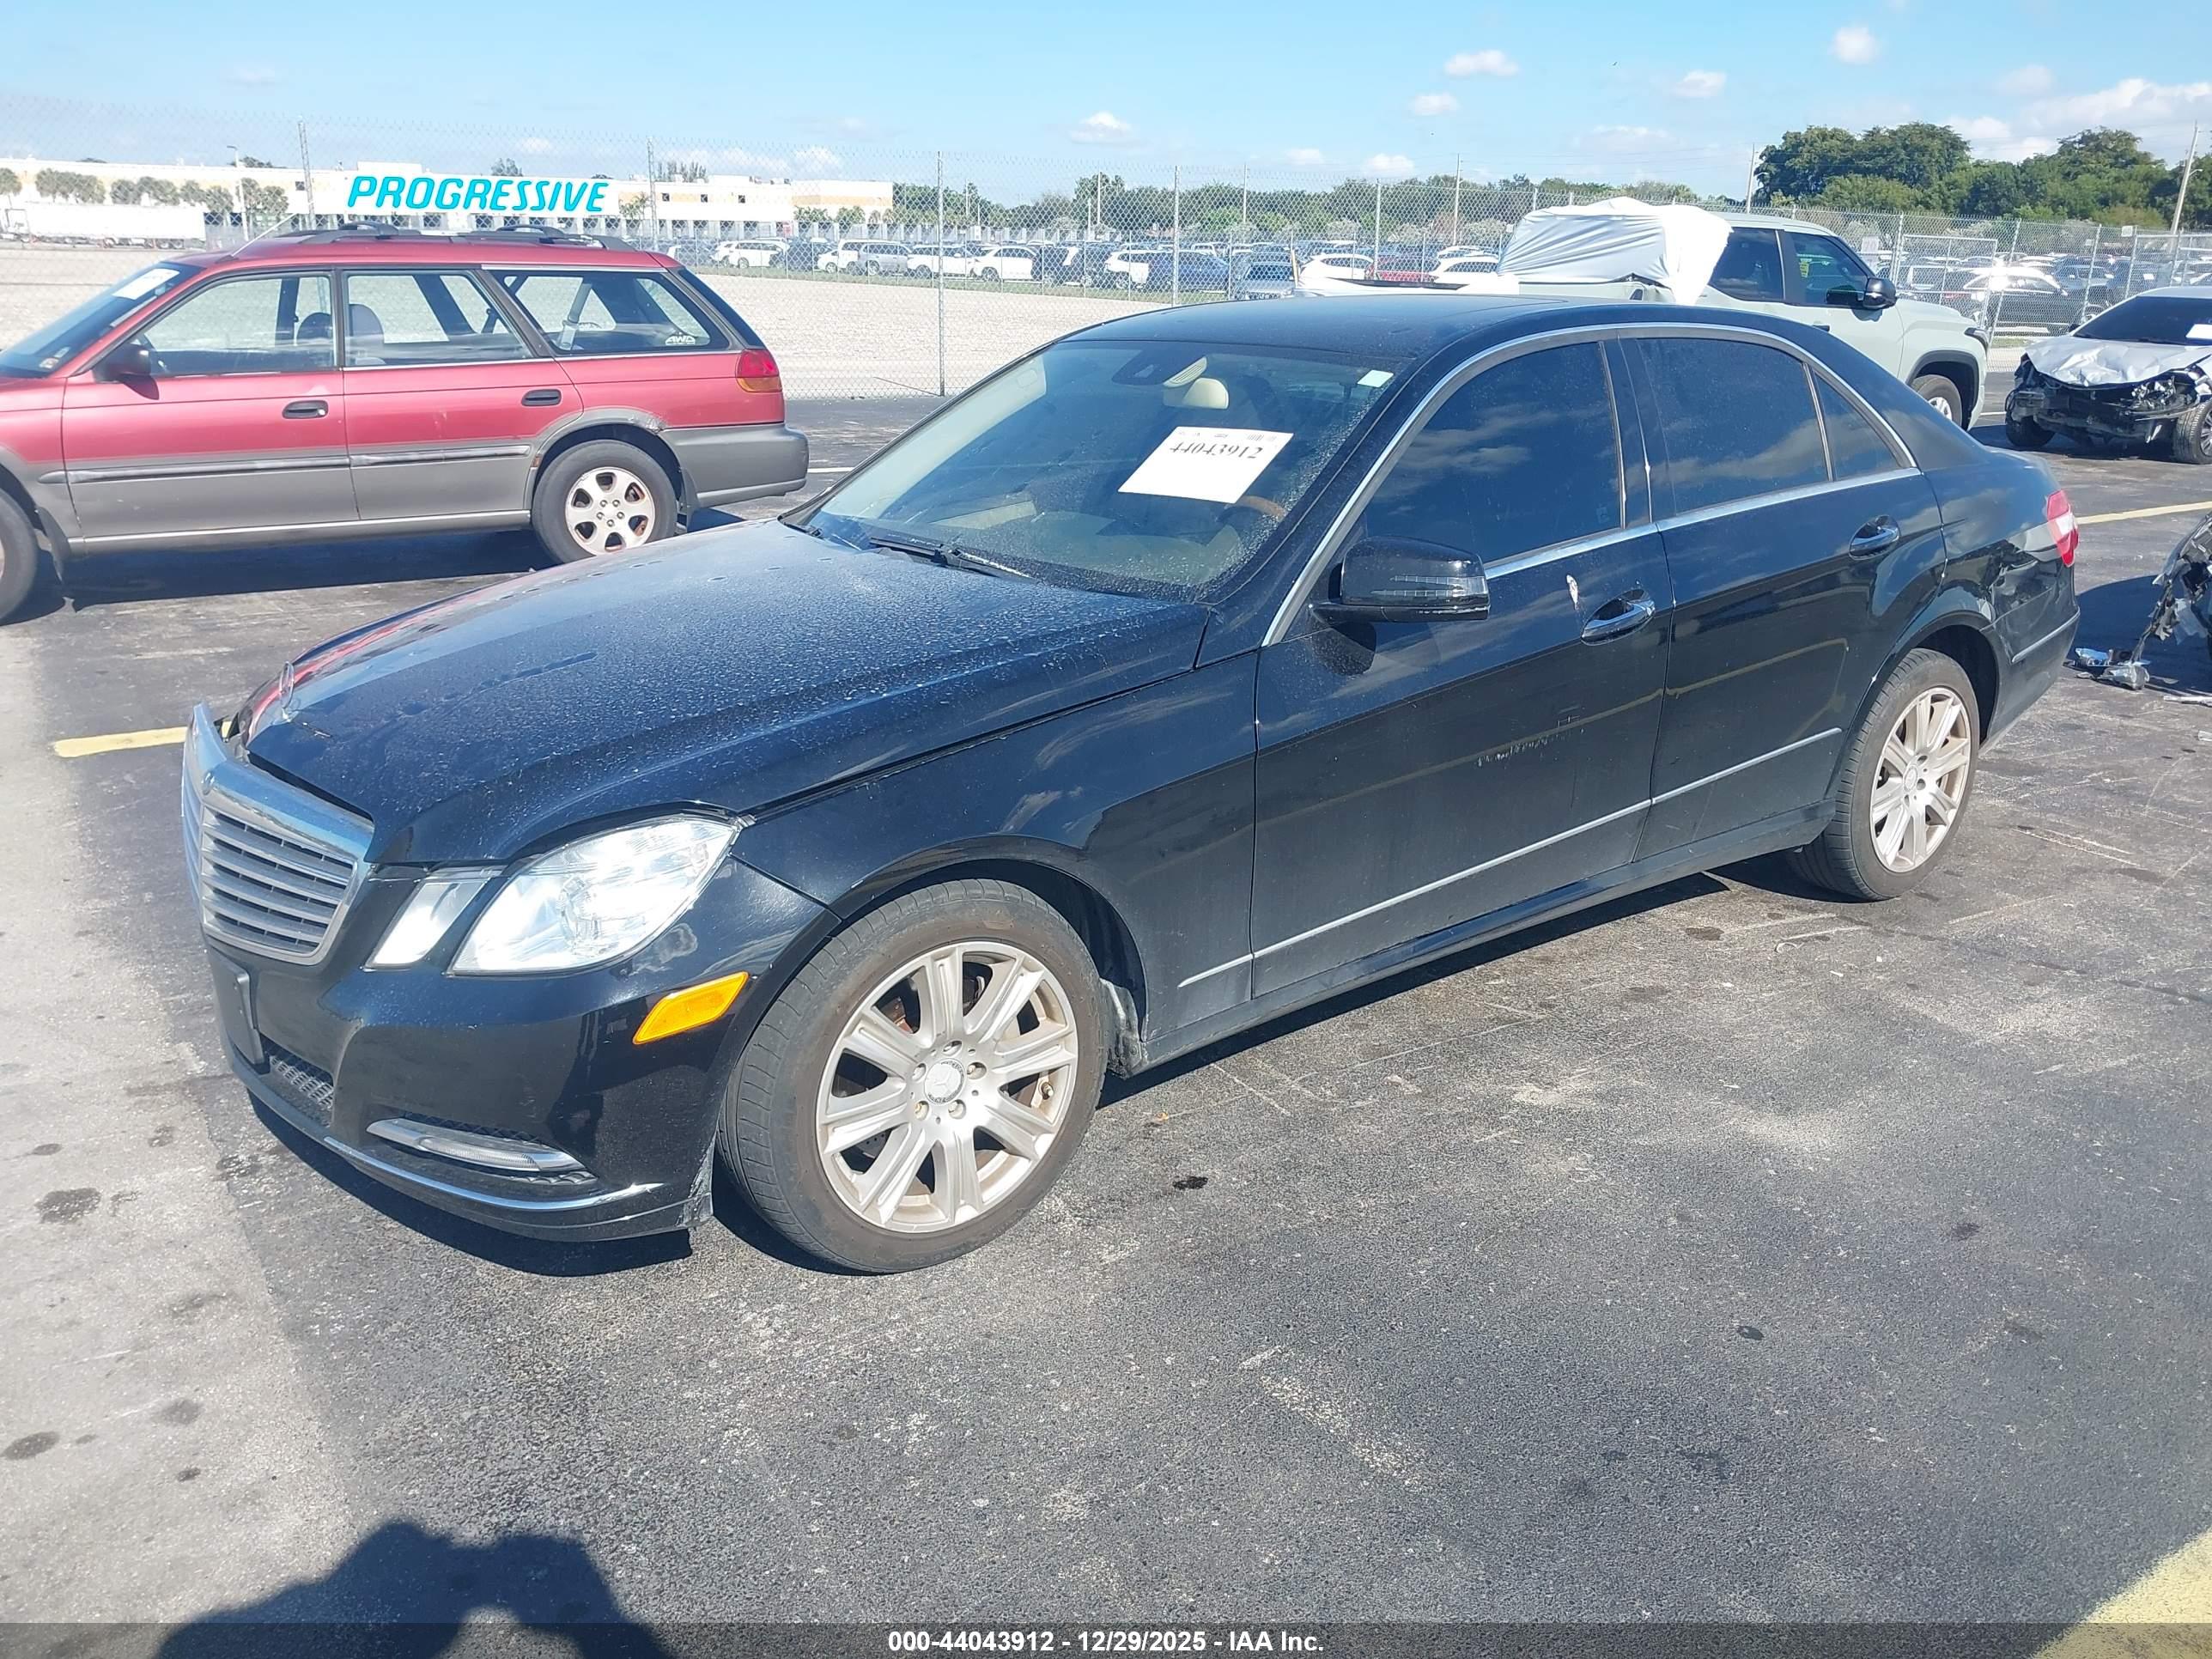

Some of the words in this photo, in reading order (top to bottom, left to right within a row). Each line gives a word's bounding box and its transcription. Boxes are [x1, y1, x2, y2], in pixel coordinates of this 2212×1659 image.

[347, 175, 610, 213] PROGRESSIVE
[665, 335, 696, 345] AWD
[1170, 441, 1263, 459] 44043912
